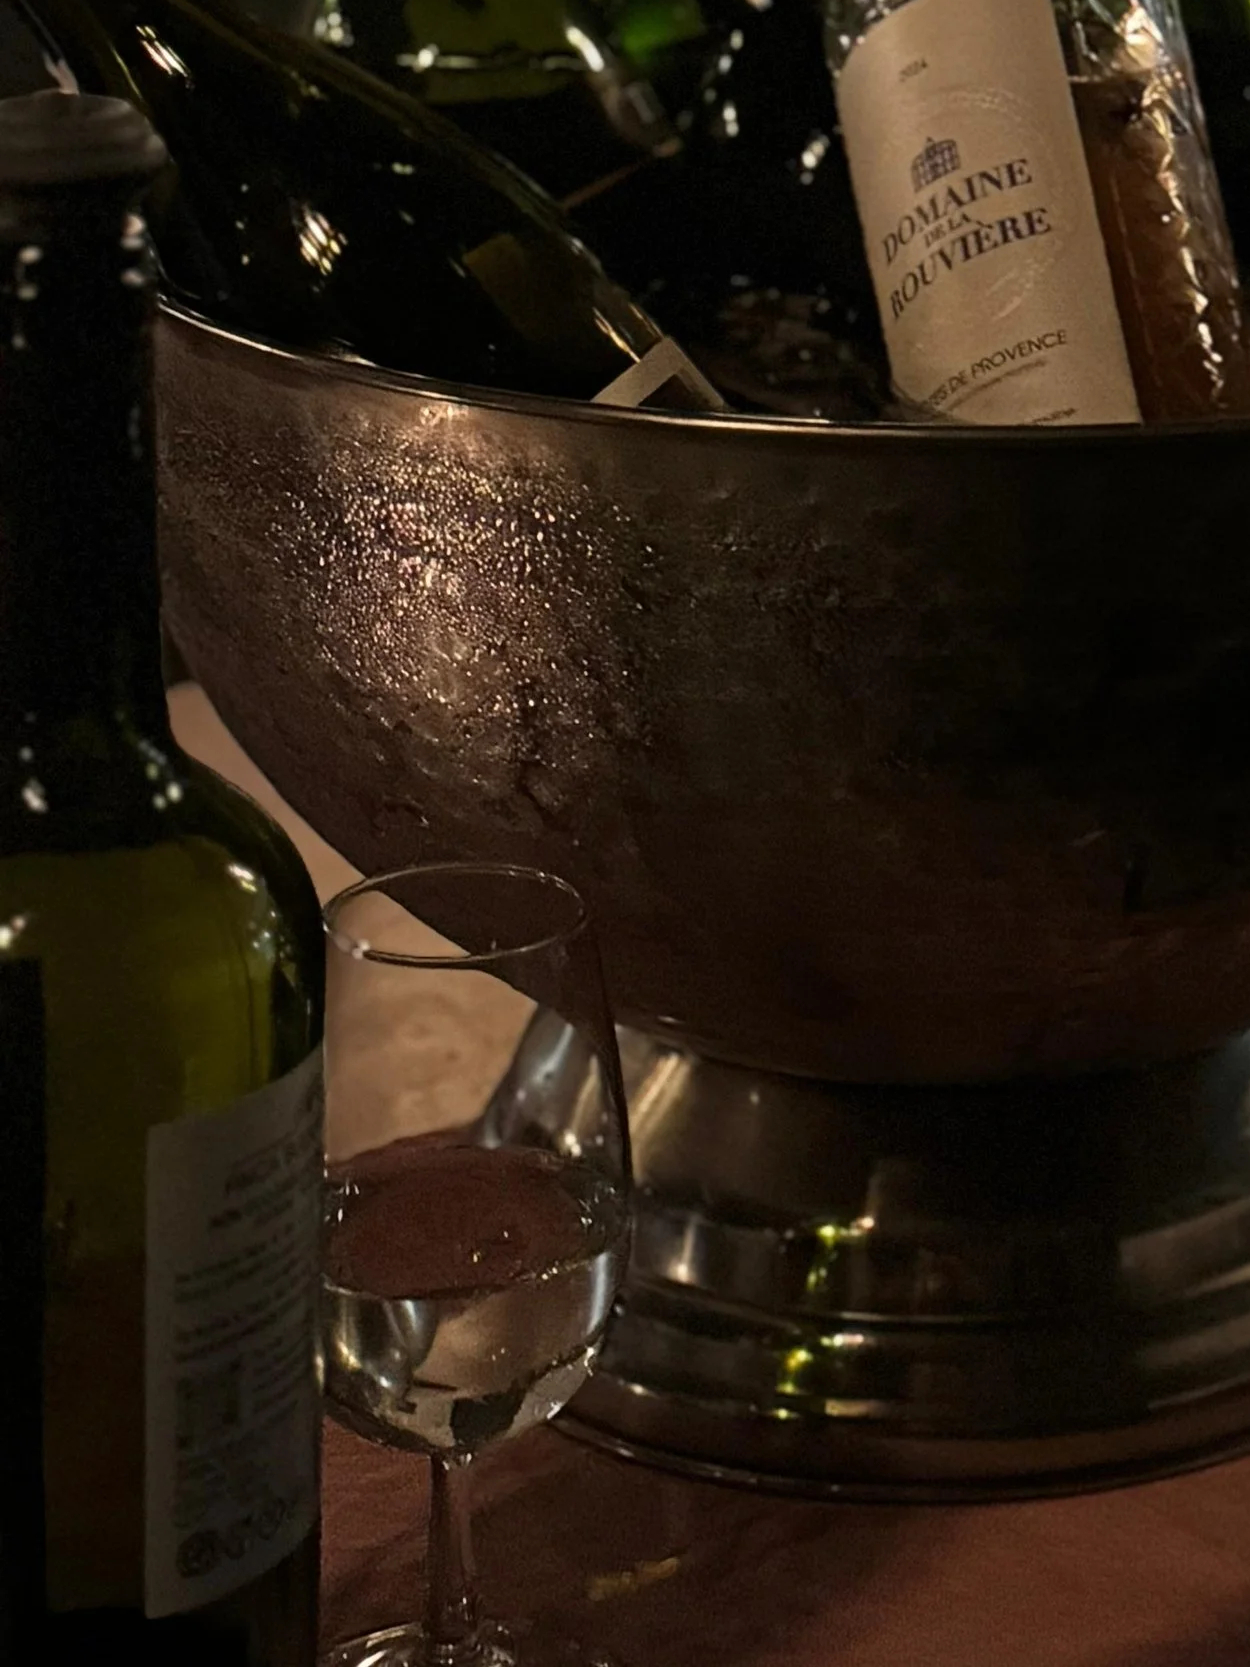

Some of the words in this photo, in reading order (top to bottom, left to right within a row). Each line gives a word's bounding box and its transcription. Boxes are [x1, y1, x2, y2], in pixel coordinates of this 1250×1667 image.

[882, 158, 1032, 266] DOMAINE
[924, 223, 946, 248] DE
[947, 213, 972, 231] LA
[890, 207, 1052, 320] ROUVIÈRE
[971, 329, 1067, 379] PROVENCE
